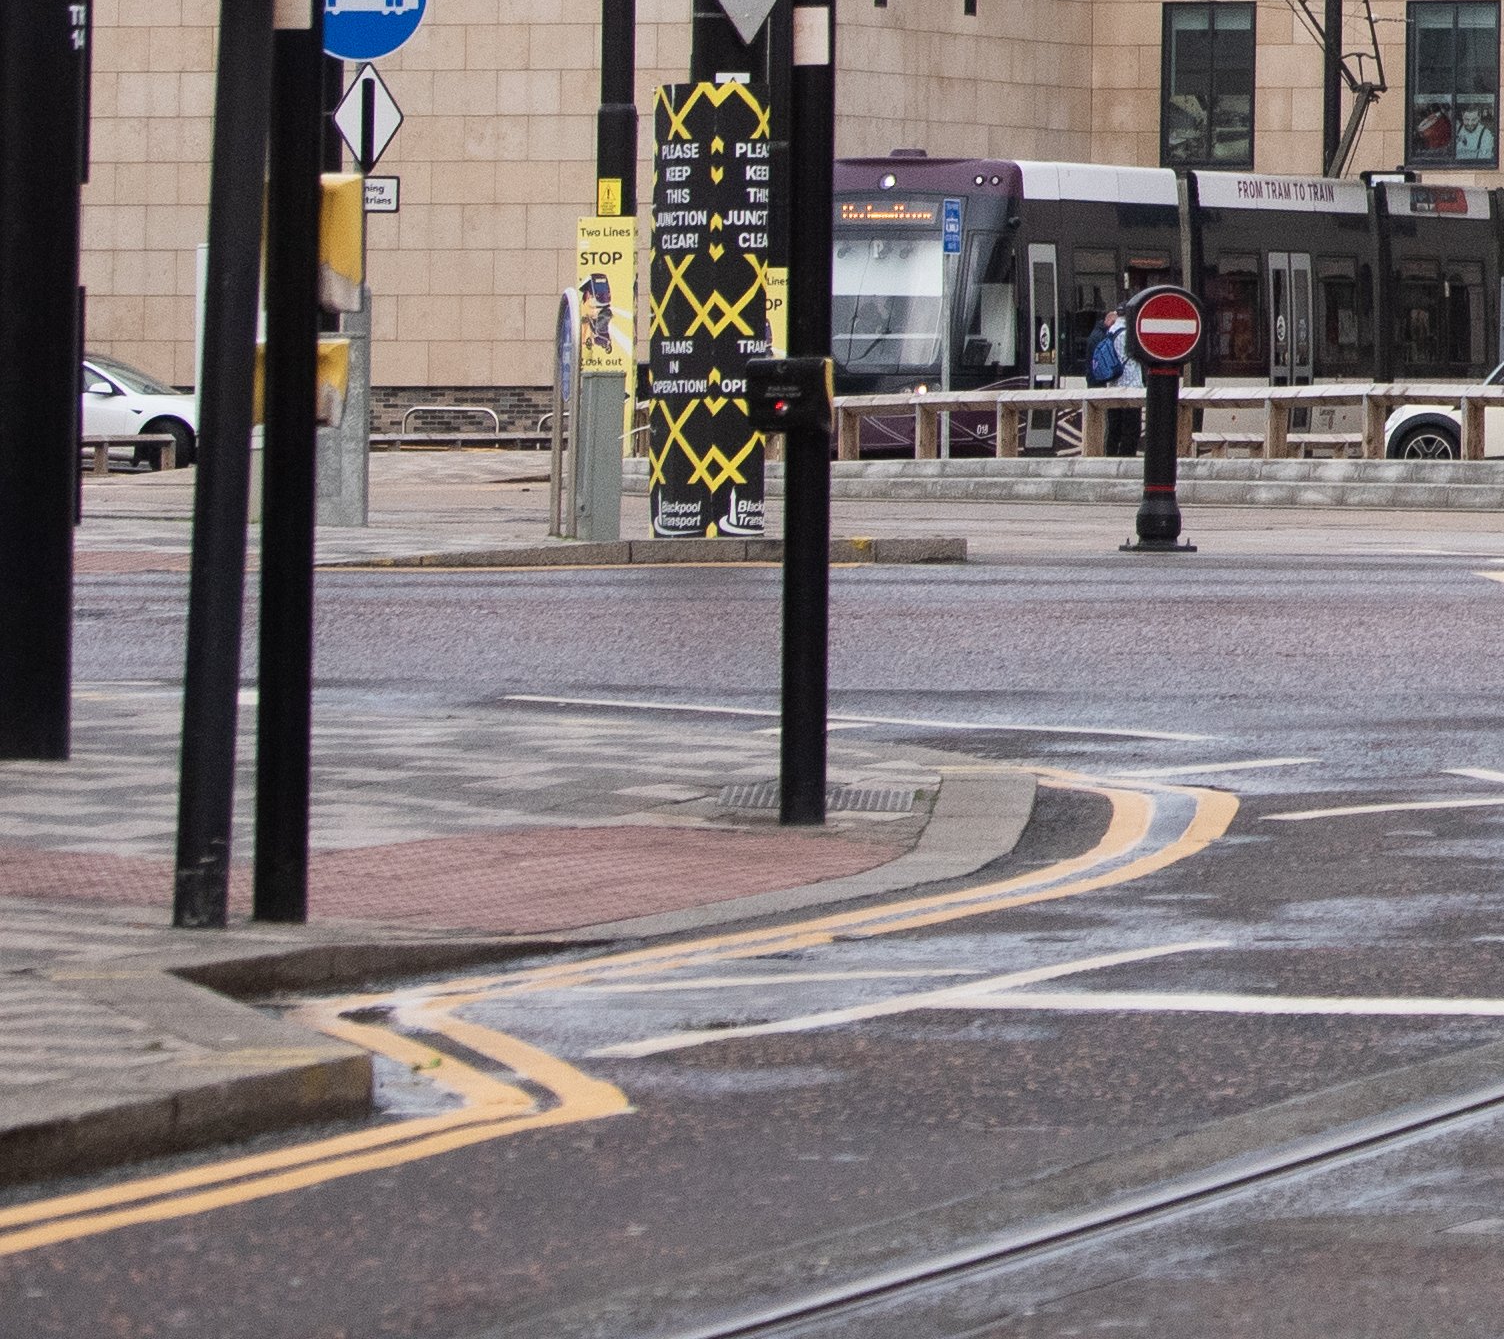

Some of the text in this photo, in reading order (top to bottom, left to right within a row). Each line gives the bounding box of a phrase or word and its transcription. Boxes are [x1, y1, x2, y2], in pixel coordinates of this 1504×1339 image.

[661, 143, 699, 160] PLEASE
[735, 142, 769, 158] PLEA
[665, 166, 691, 182] KEEP
[666, 188, 690, 204] THIS
[1237, 181, 1335, 202] FROM TRAM TO TRAIN
[656, 210, 707, 227] JUNCTION
[723, 210, 769, 225] JUNCT
[580, 226, 631, 237] Two Lines
[661, 233, 699, 249] CLEAR!
[738, 232, 768, 248] CLEA
[579, 251, 623, 266] STOP
[661, 340, 693, 354] TRAMS
[605, 357, 622, 367] out
[669, 361, 679, 373] IN
[652, 379, 708, 394] OPERATION!
[661, 500, 701, 514] Blackpool
[661, 514, 701, 528] Transport
